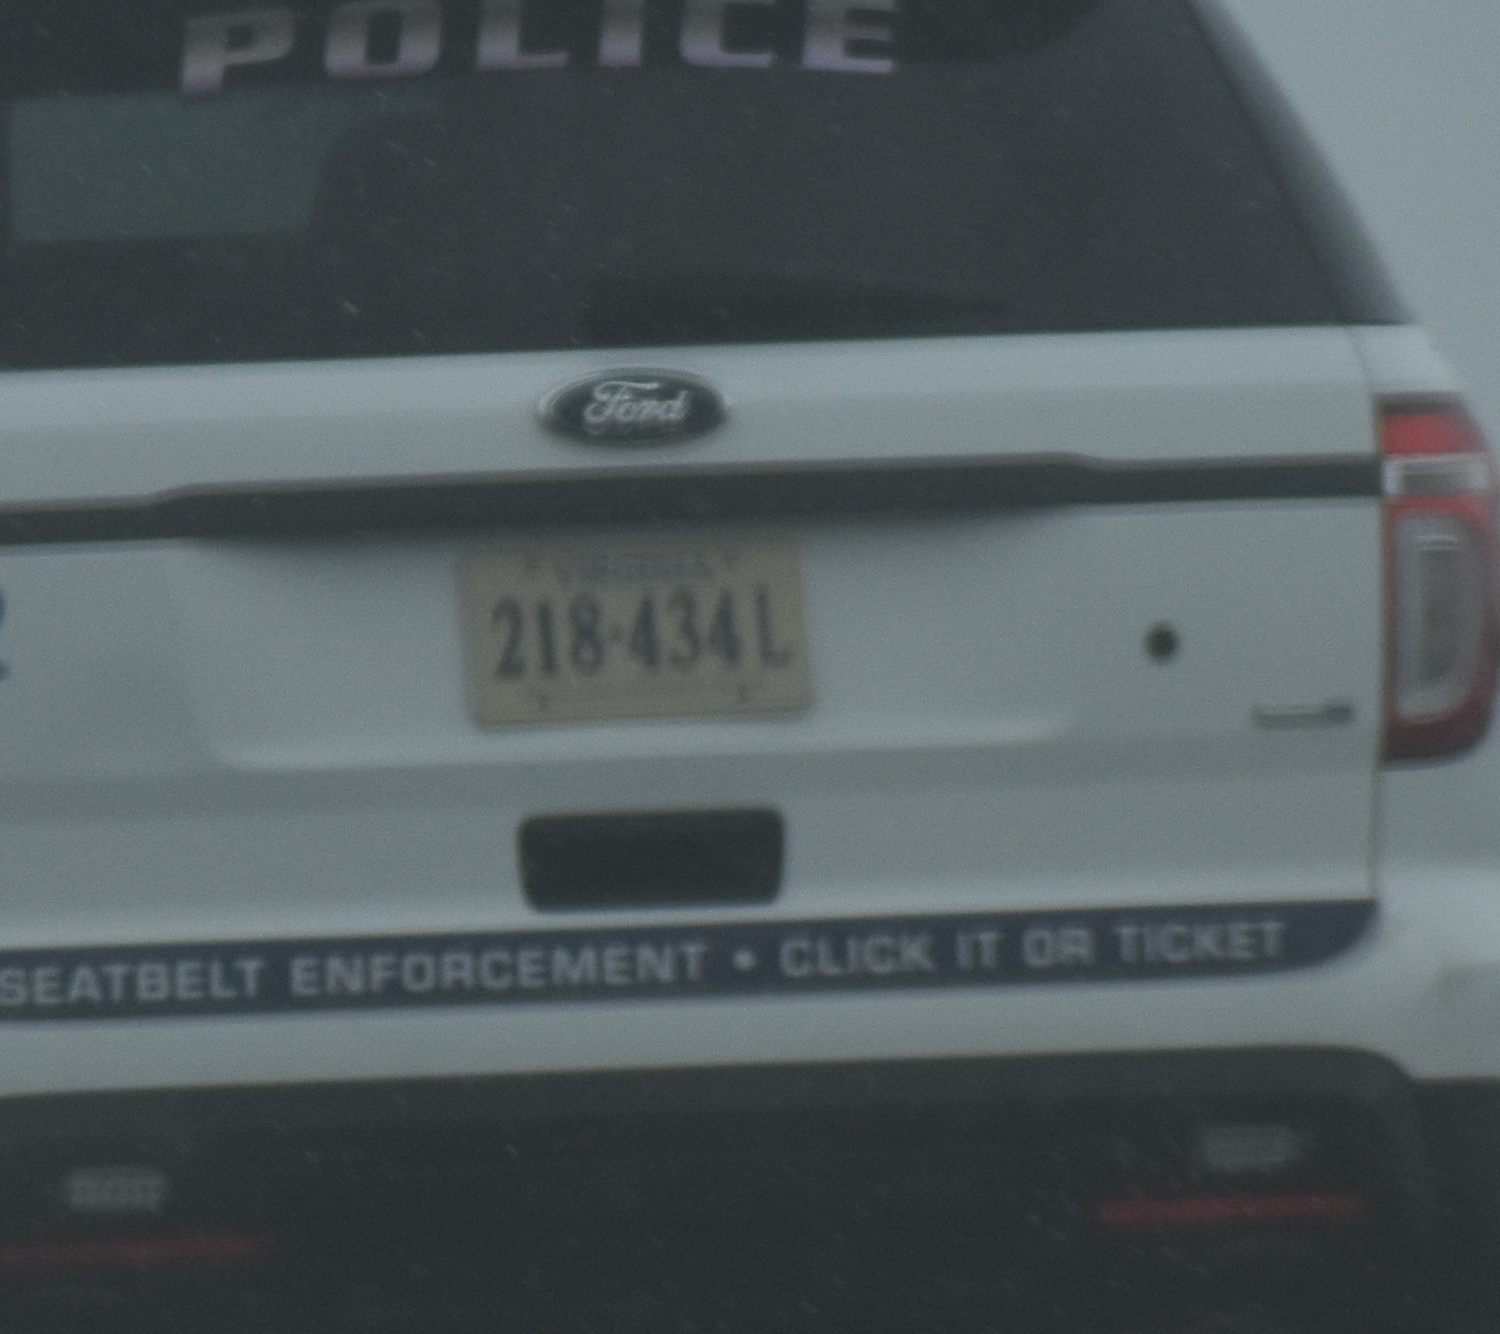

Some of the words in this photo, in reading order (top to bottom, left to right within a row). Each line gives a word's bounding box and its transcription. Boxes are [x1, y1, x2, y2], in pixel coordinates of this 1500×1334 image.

[584, 380, 692, 427] Ford
[289, 942, 706, 997] ENFORCEMENT
[779, 933, 937, 978] CLICK
[956, 930, 1001, 971] IT
[1022, 925, 1095, 969] OR
[1118, 920, 1287, 965] TICKET
